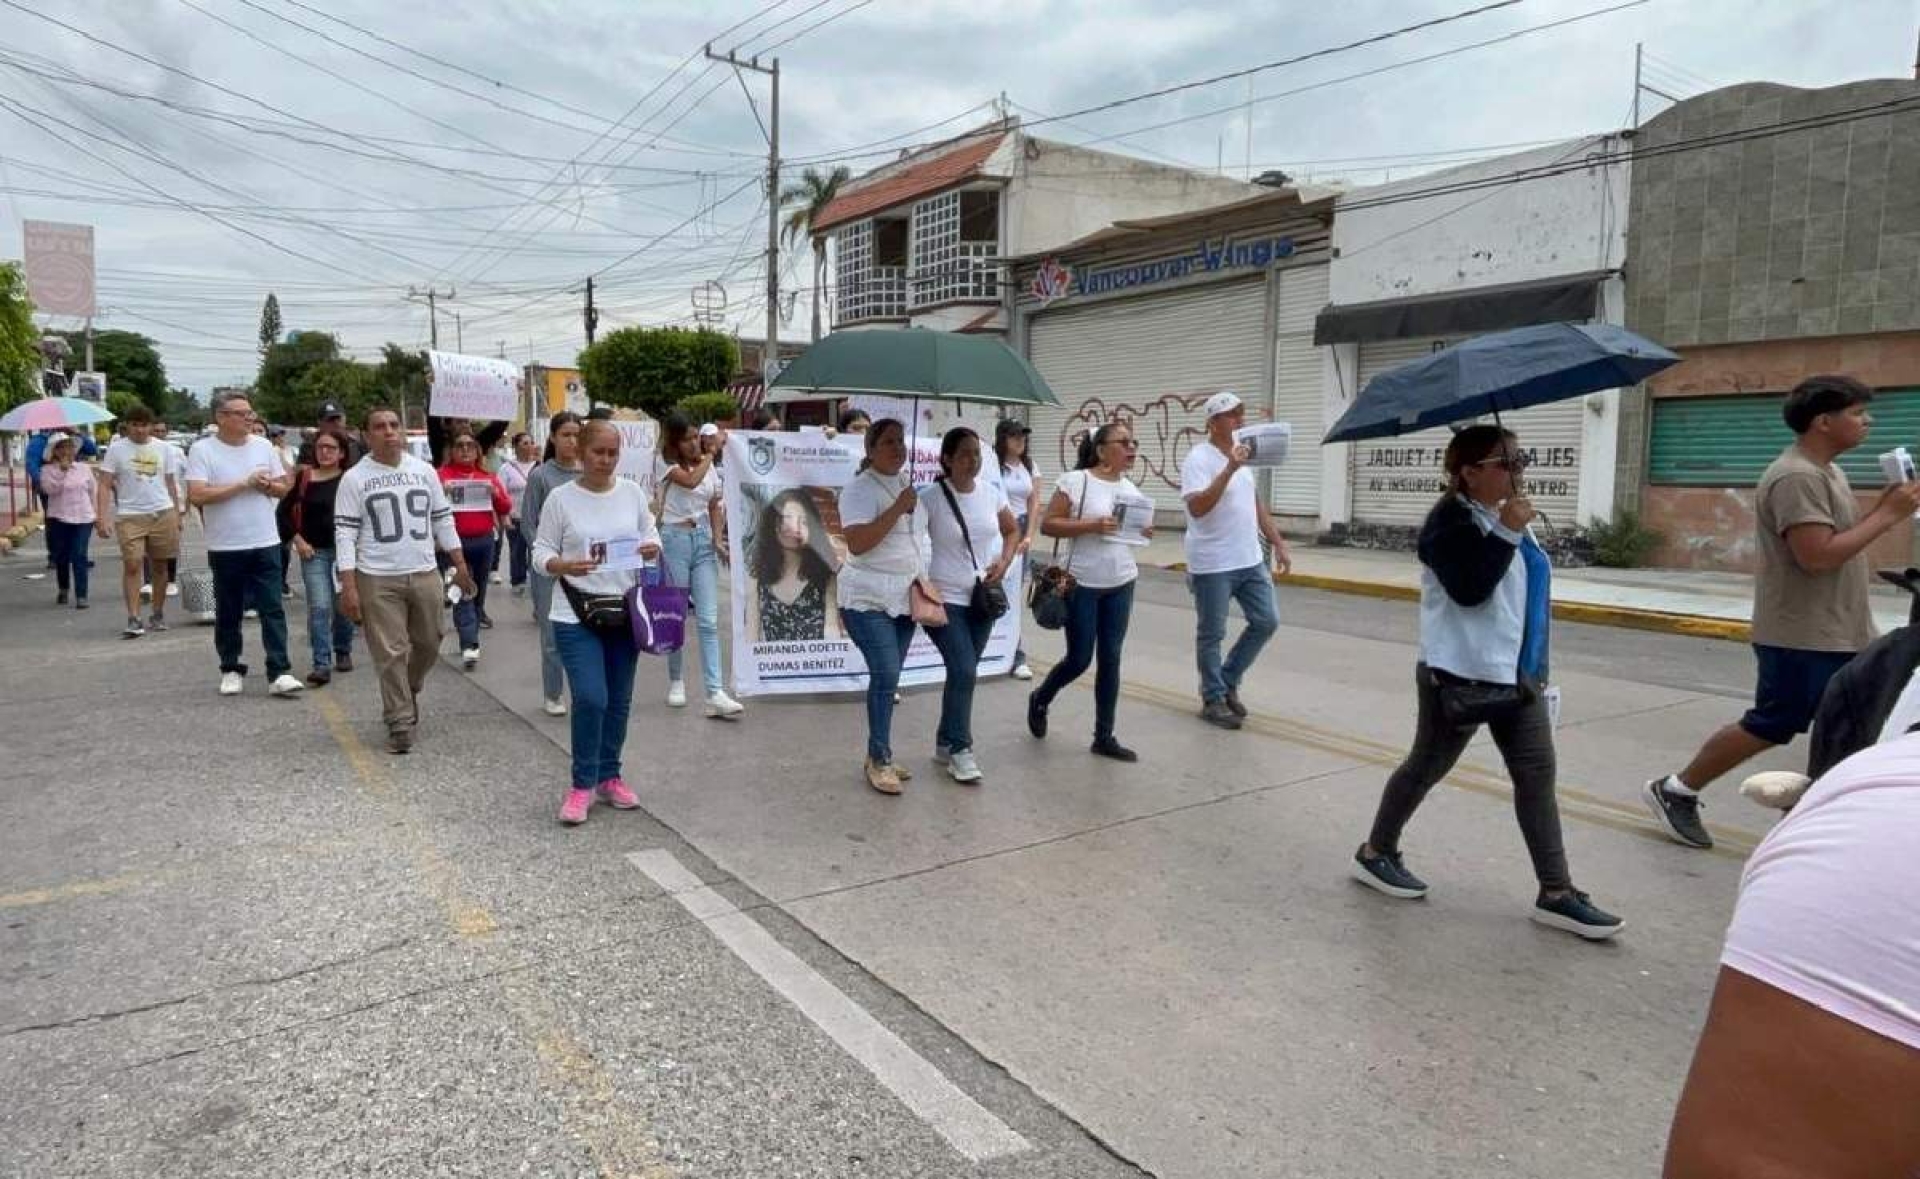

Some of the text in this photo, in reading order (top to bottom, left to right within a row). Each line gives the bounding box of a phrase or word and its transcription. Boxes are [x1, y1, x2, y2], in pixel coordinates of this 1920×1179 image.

[1076, 234, 1294, 295] Vancouver Wings
[365, 489, 430, 542] 09
[753, 643, 849, 656] MIRANDA ODETTE
[758, 662, 800, 672] DUMAS
